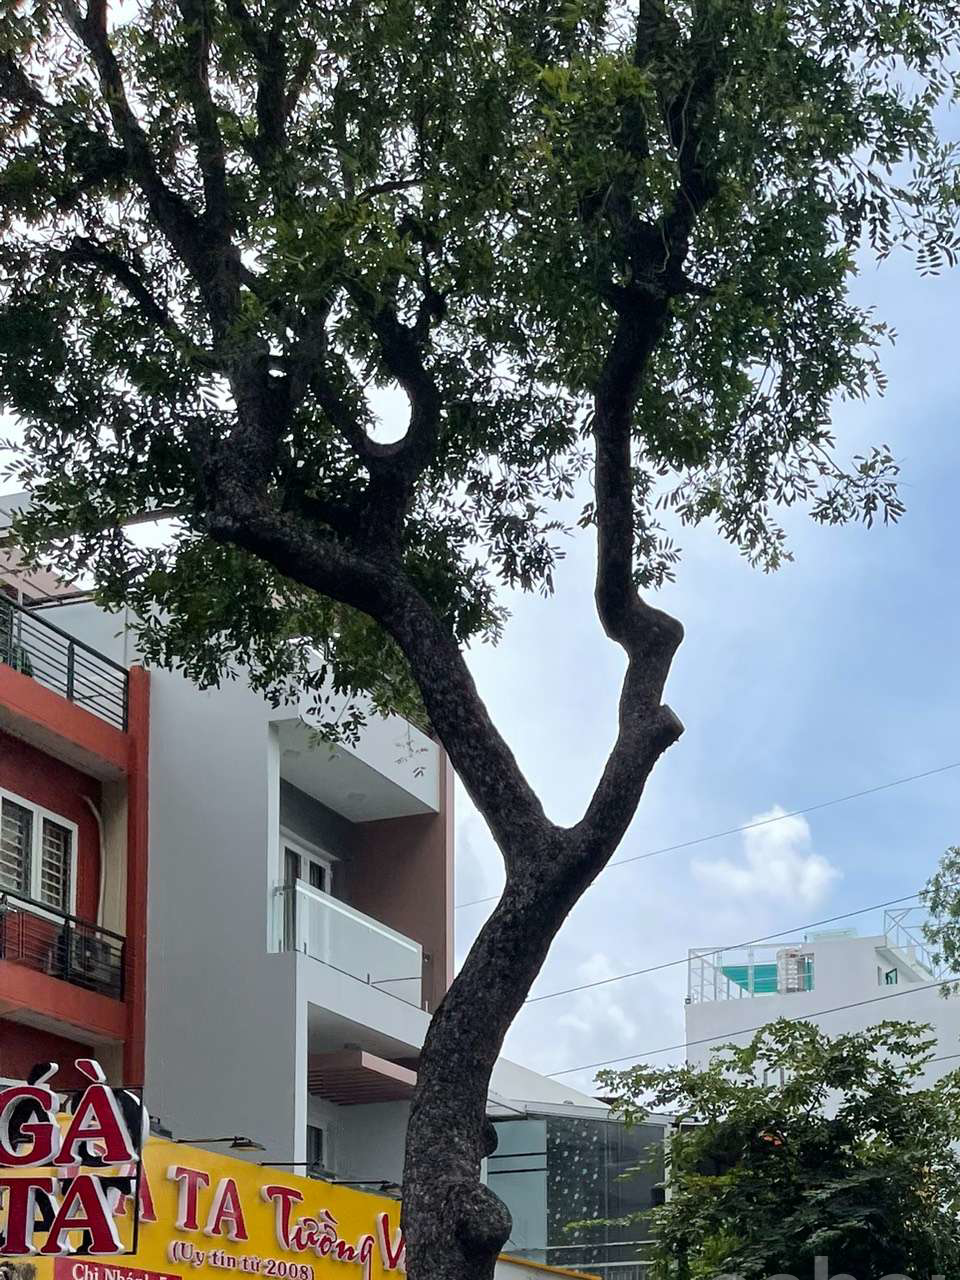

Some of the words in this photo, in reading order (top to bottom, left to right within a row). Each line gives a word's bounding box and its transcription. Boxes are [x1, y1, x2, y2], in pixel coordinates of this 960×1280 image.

[0, 1059, 139, 1167] GÀ
[0, 1174, 124, 1256] TA
[168, 1165, 248, 1241] TA
